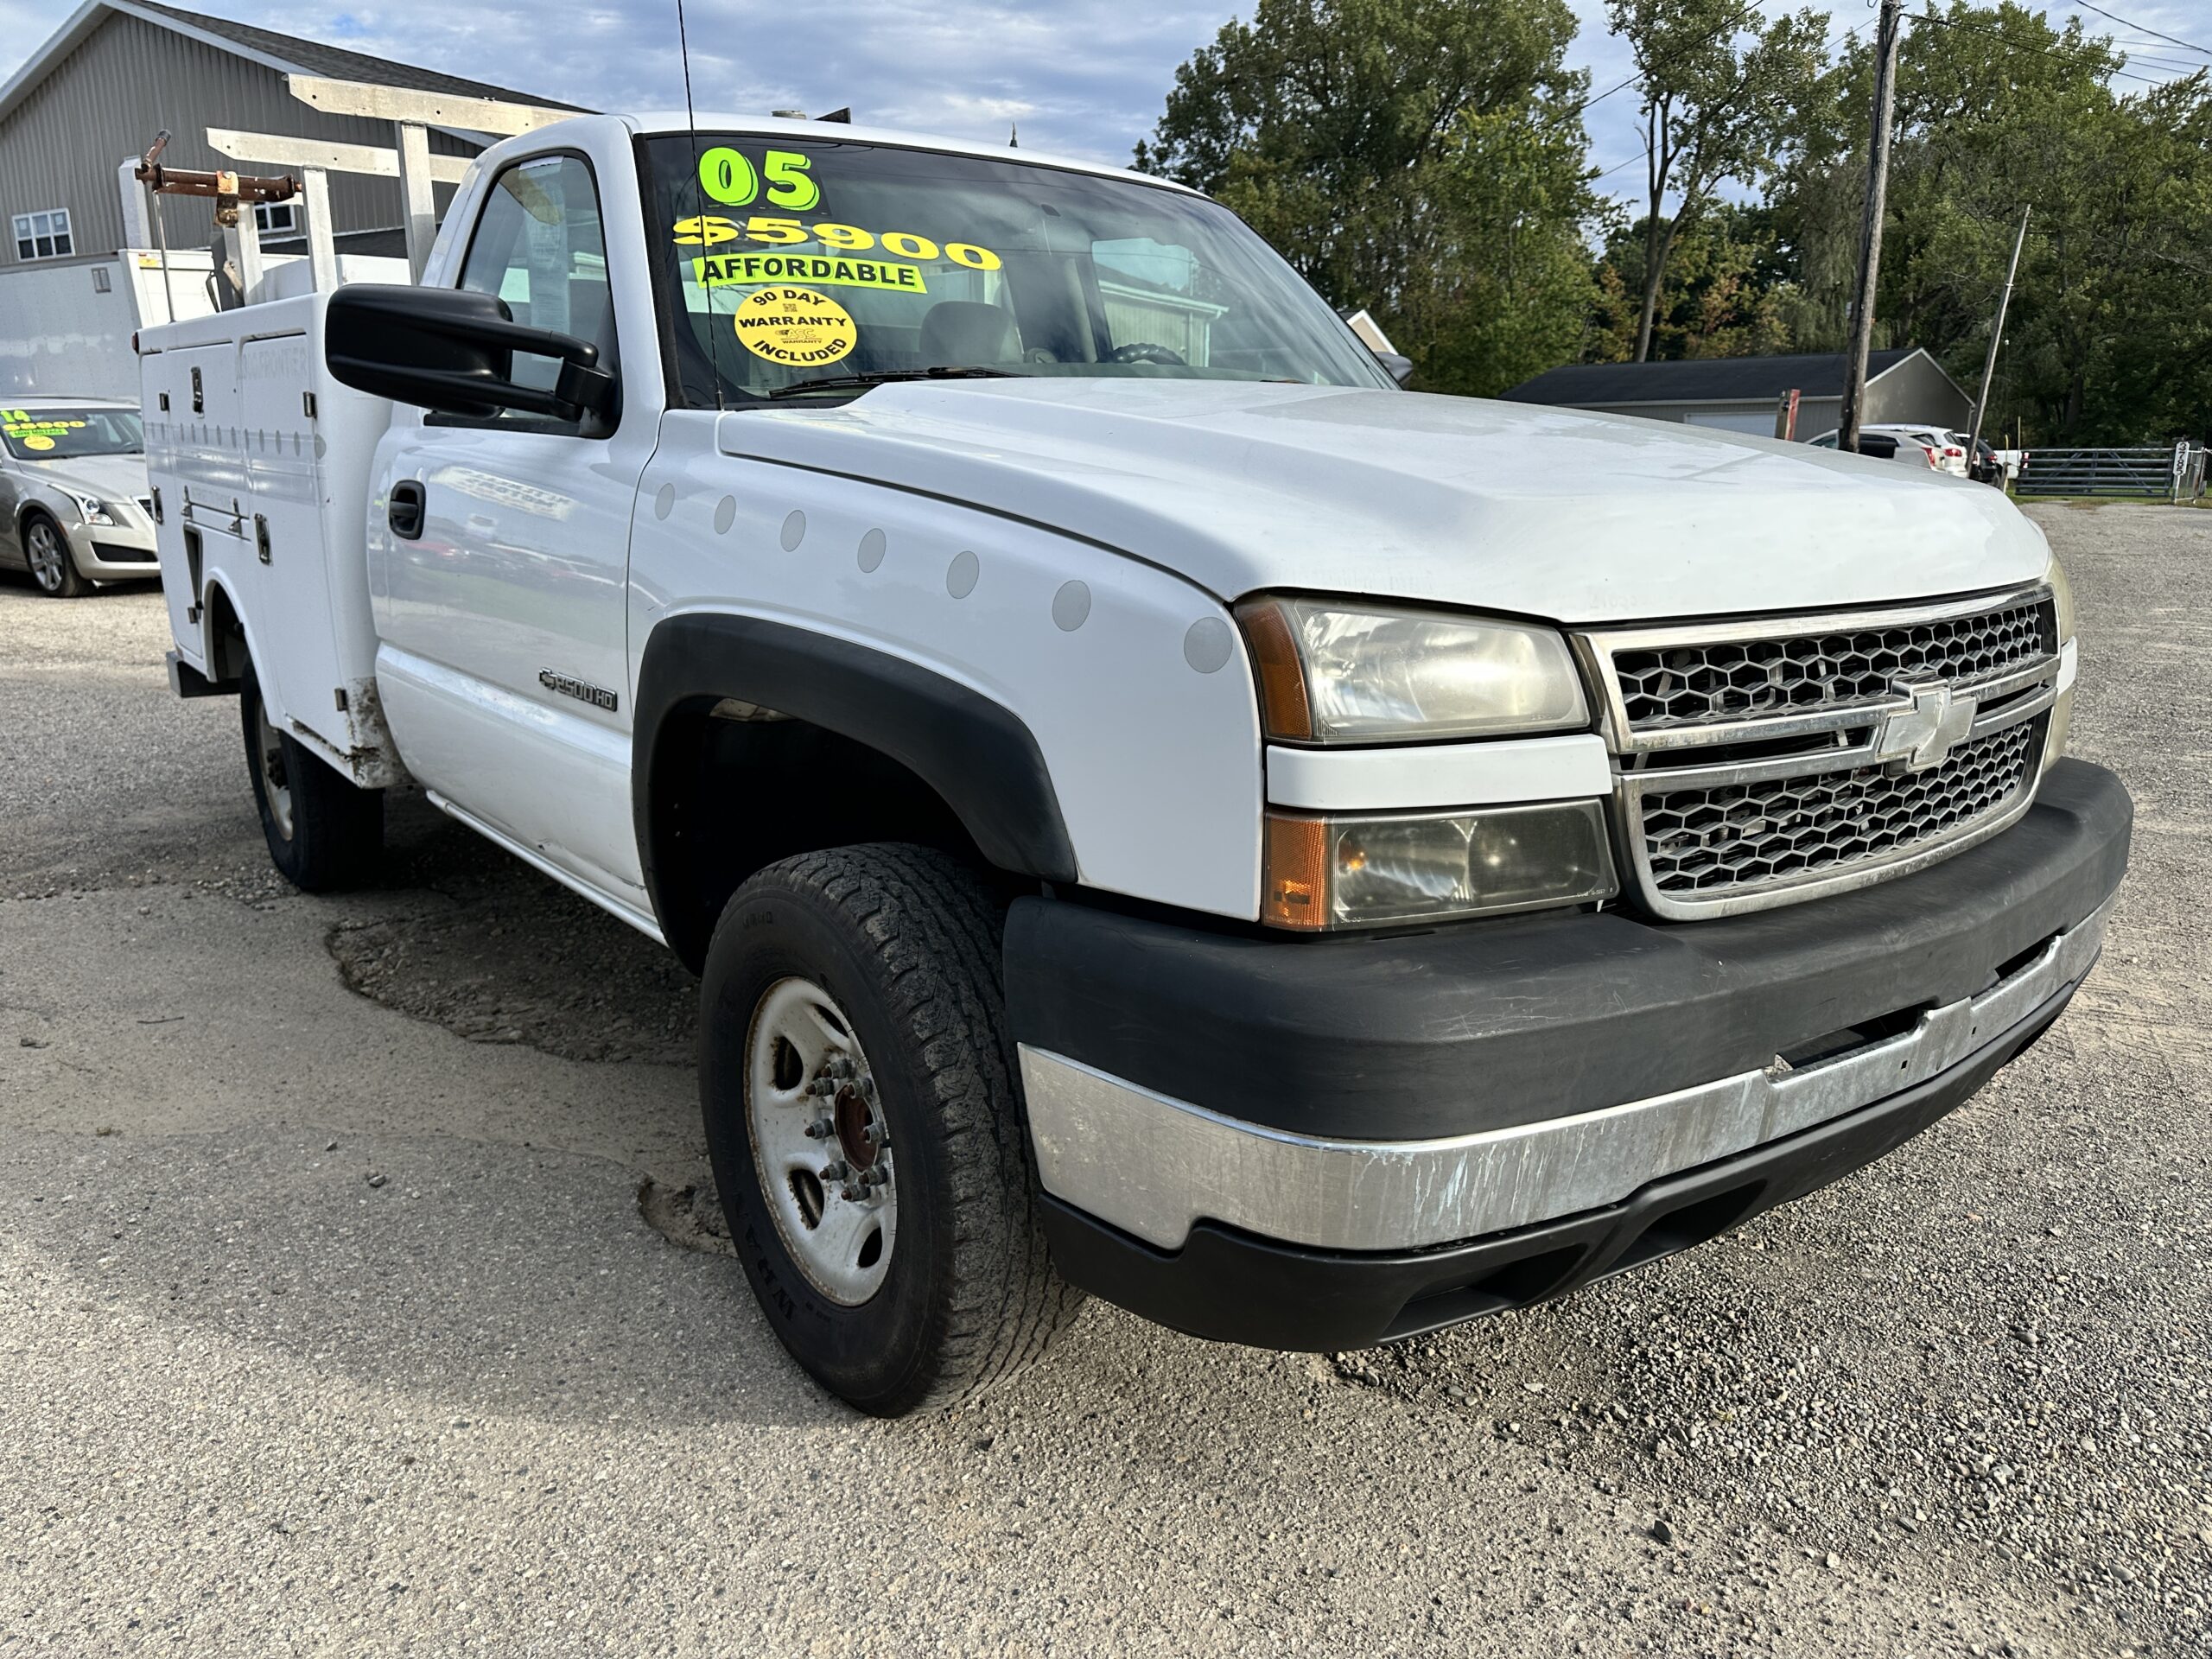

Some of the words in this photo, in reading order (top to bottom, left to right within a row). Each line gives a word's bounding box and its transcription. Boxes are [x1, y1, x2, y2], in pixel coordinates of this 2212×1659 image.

[699, 147, 820, 211] 05
[672, 215, 1002, 270] $5900
[702, 257, 917, 287] AFFORDABLE
[753, 291, 777, 306] 90
[783, 289, 826, 306] DAY
[739, 316, 847, 327] WARRANTY
[753, 338, 848, 362] INCLUDED
[2176, 442, 2187, 475] 3785
